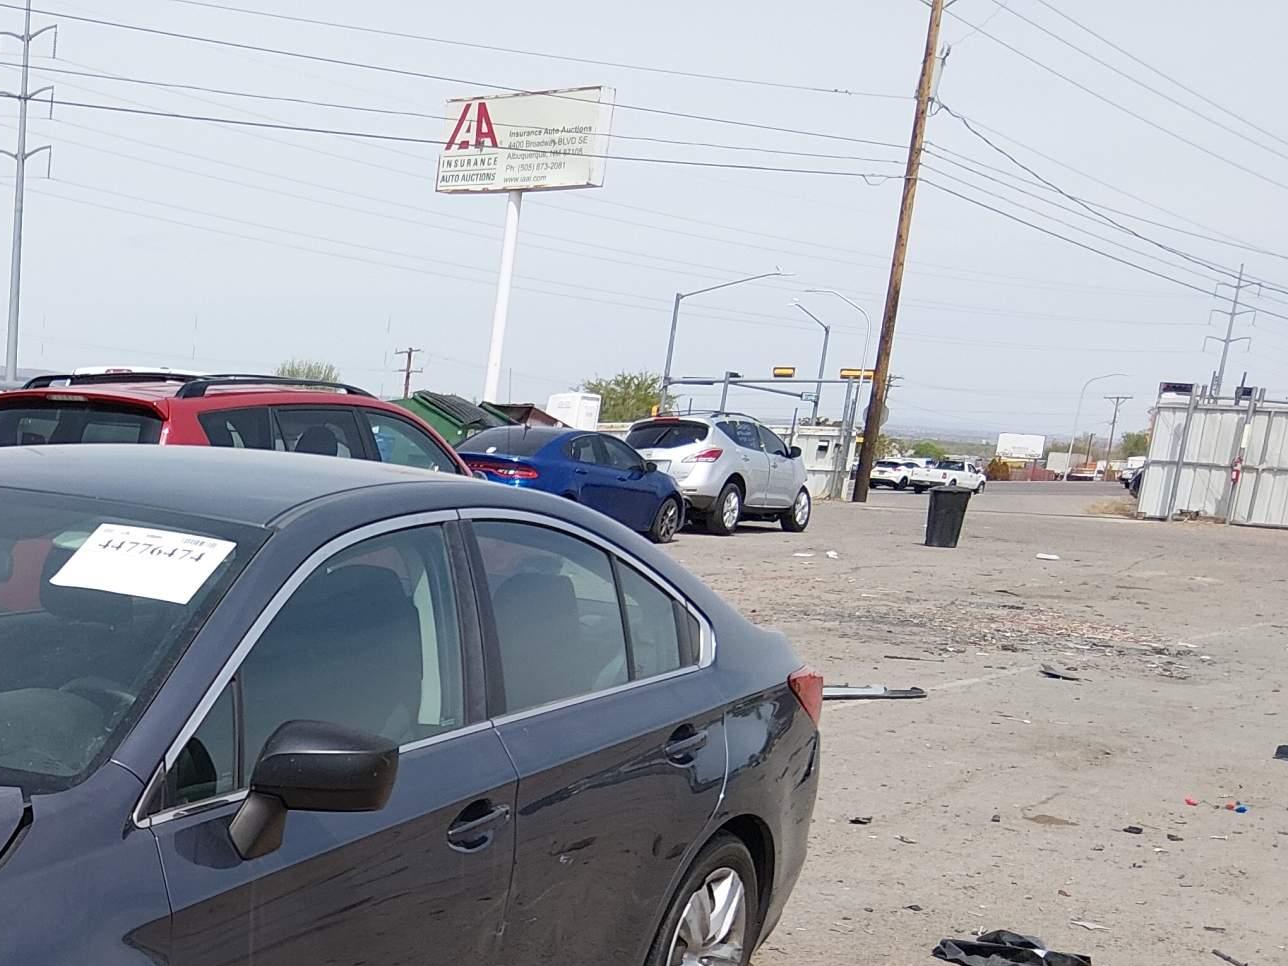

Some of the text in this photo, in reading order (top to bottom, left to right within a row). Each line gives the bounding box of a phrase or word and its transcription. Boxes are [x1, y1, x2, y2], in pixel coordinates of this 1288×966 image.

[509, 125, 592, 138] Insurance Auto Auctions
[557, 136, 577, 146] BLVD
[578, 135, 588, 144] SE
[442, 156, 498, 168] INSURANCE
[440, 172, 496, 183] AUTO AUCTIONS
[98, 539, 205, 562] 44776474
